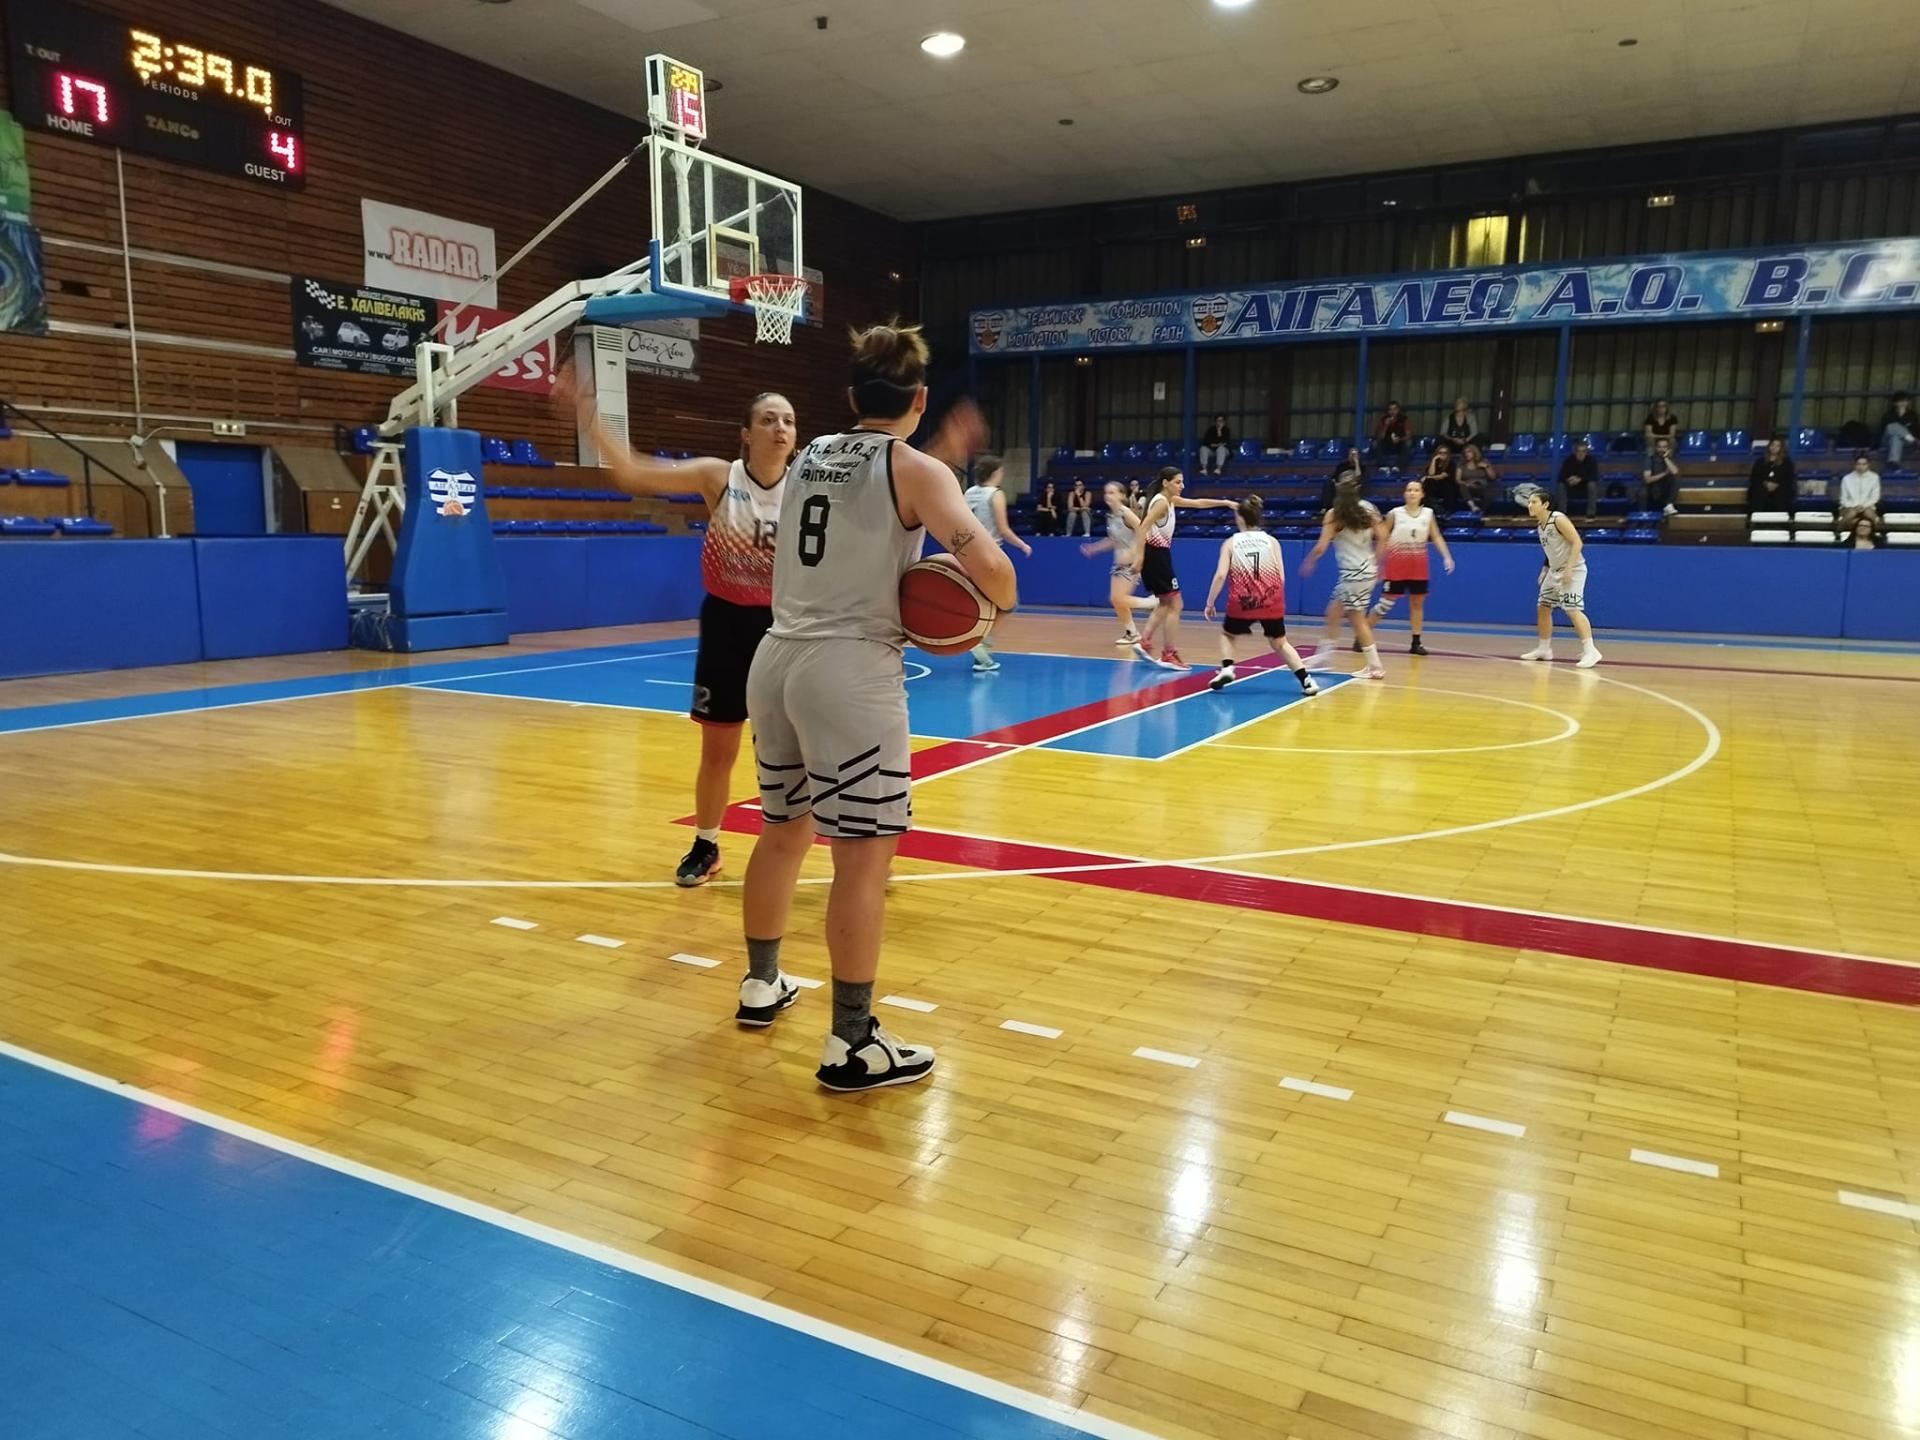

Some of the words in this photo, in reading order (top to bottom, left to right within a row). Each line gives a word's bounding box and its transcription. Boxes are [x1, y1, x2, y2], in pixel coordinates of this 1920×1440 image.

[59, 74, 109, 122] 17
[142, 78, 199, 101] PERIODS
[274, 116, 293, 127] OUT
[676, 87, 701, 134] 15
[46, 113, 95, 137] HOME
[270, 132, 295, 169] 4
[244, 162, 287, 182] GUEST
[389, 226, 482, 281] RADAR
[1109, 301, 1182, 320] COMPETITION
[1224, 274, 1520, 338] ΑΙΓΑΛΕΩ
[1007, 329, 1069, 347] MOTIVATION
[1087, 327, 1133, 344] VICTORY
[1152, 325, 1185, 341] FAITH
[312, 346, 328, 355] CAR
[332, 348, 353, 358] MOTO
[355, 352, 369, 360] ATV
[798, 494, 831, 567] 8
[1244, 551, 1260, 581] 7
